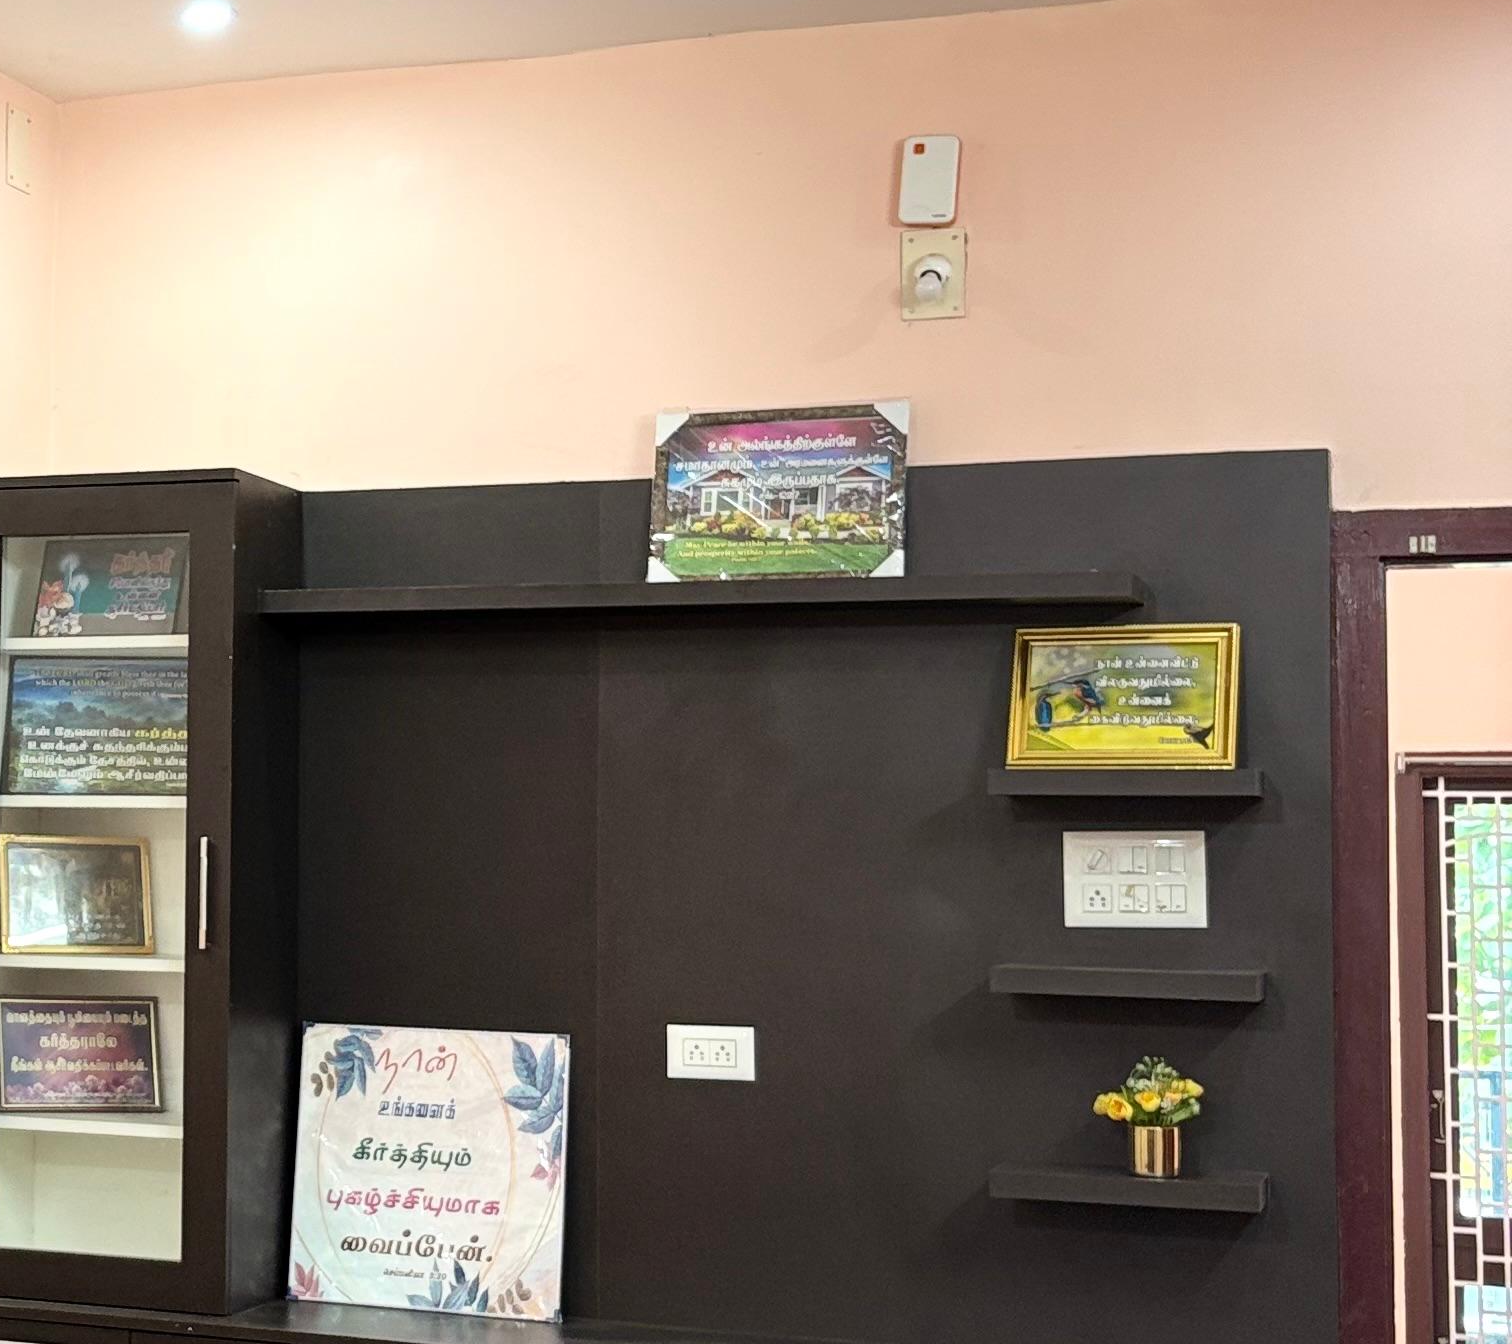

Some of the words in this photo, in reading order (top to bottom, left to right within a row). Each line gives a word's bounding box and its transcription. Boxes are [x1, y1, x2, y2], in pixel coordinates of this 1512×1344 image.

[707, 437, 733, 453] உன்
[737, 548, 764, 557] within
[23, 726, 50, 737] உன்
[54, 726, 131, 738] தேவனாகிய
[39, 1032, 118, 1050] கர்த்தராலே
[375, 1044, 458, 1095] நான்
[378, 1095, 456, 1120] உங்களைக்
[352, 1137, 472, 1172] கீர்த்தியும்
[326, 1187, 501, 1218] புகழ்ச்சியுமாக
[340, 1228, 494, 1263] வைப்பேன்.
